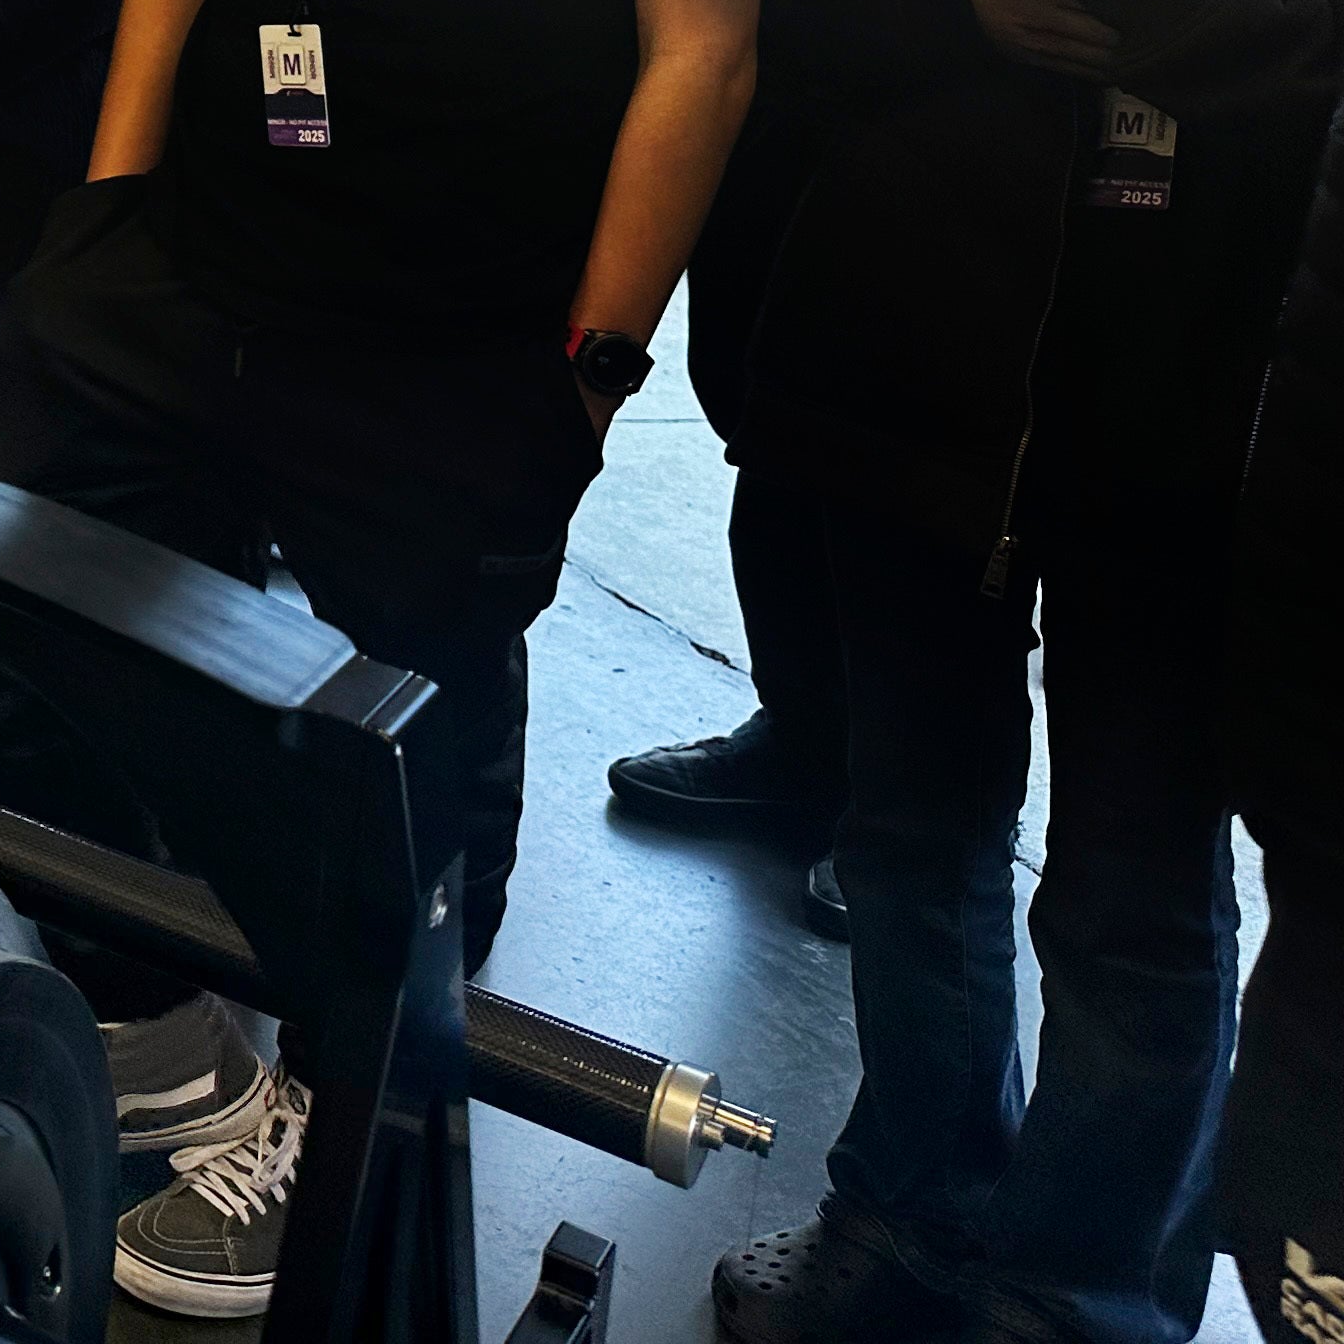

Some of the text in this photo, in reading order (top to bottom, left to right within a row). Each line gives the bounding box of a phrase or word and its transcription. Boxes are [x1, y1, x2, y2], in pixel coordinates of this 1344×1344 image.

[283, 53, 302, 76] M
[1115, 111, 1144, 135] M
[298, 129, 325, 143] 2025
[1121, 190, 1163, 205] 2025
